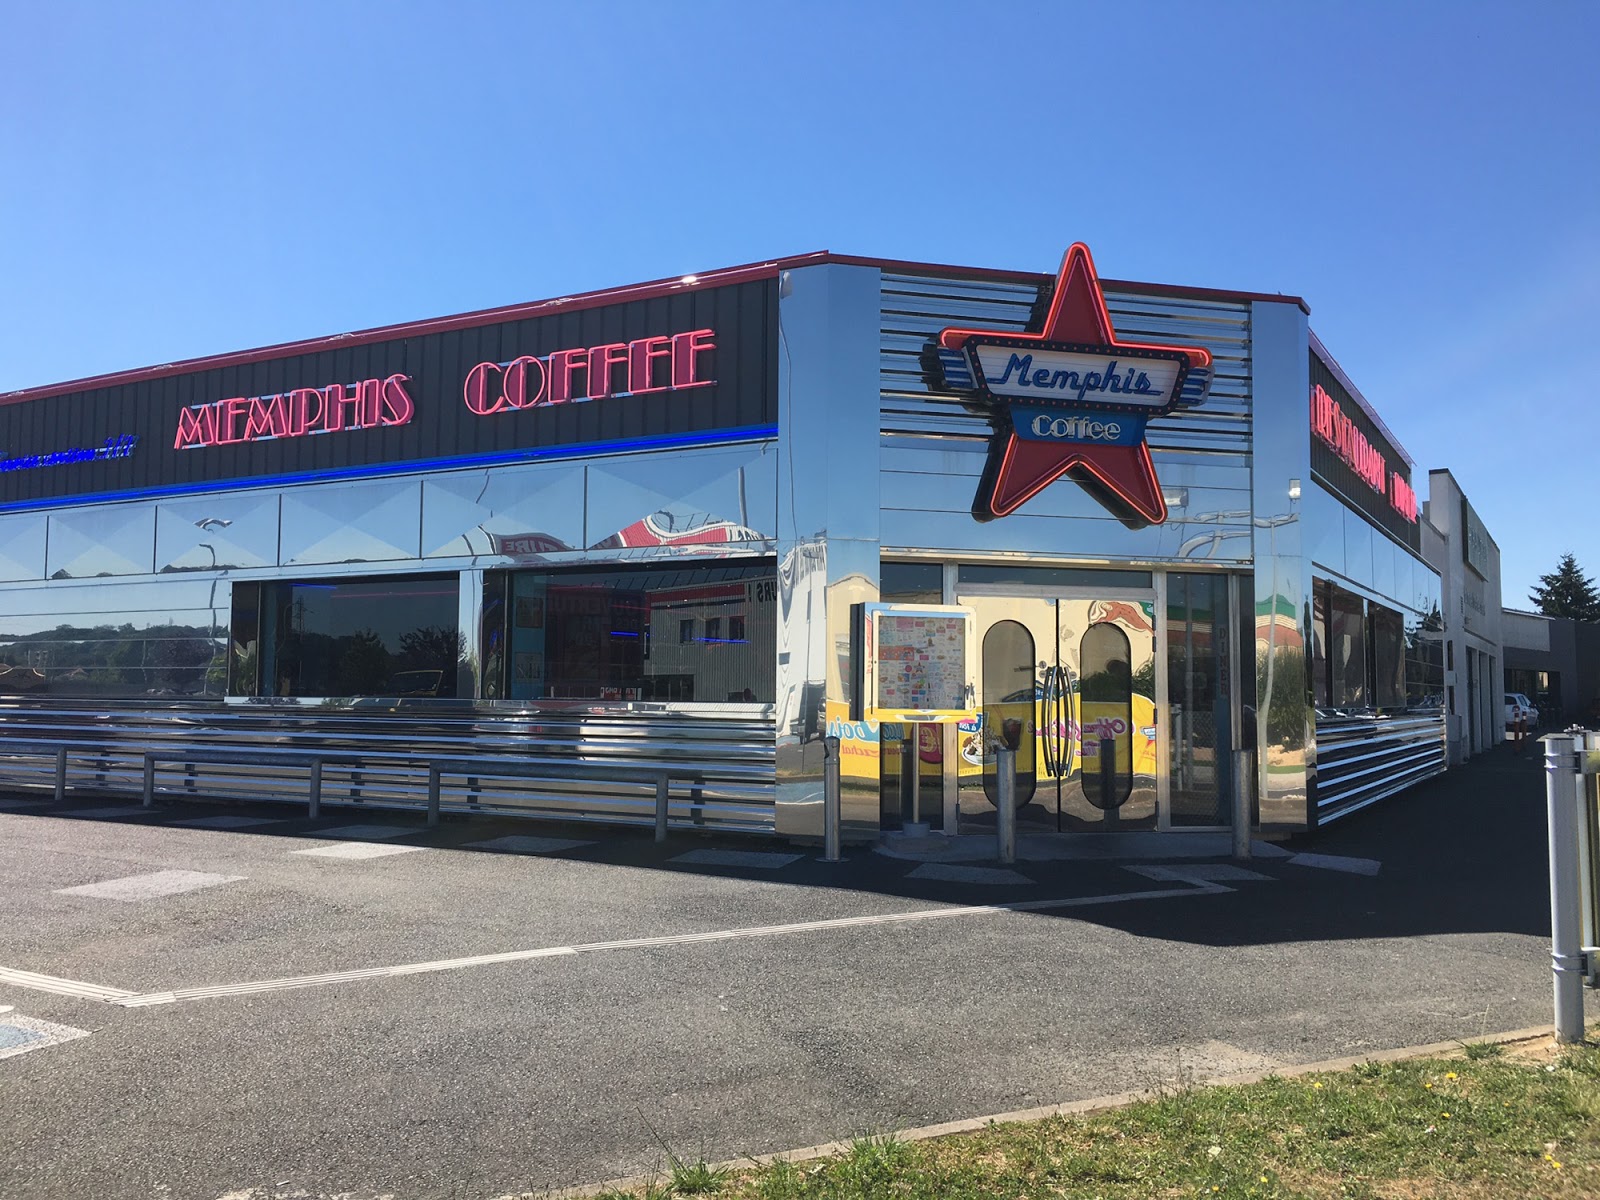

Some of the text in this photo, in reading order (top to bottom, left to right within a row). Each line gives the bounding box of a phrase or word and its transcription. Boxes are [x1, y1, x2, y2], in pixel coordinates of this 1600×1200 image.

[173, 328, 718, 450] MEMPHIS COFFEE
[987, 353, 1165, 400] Memphis
[1031, 414, 1122, 440] Coffee
[1310, 383, 1386, 495] RESTAURANT
